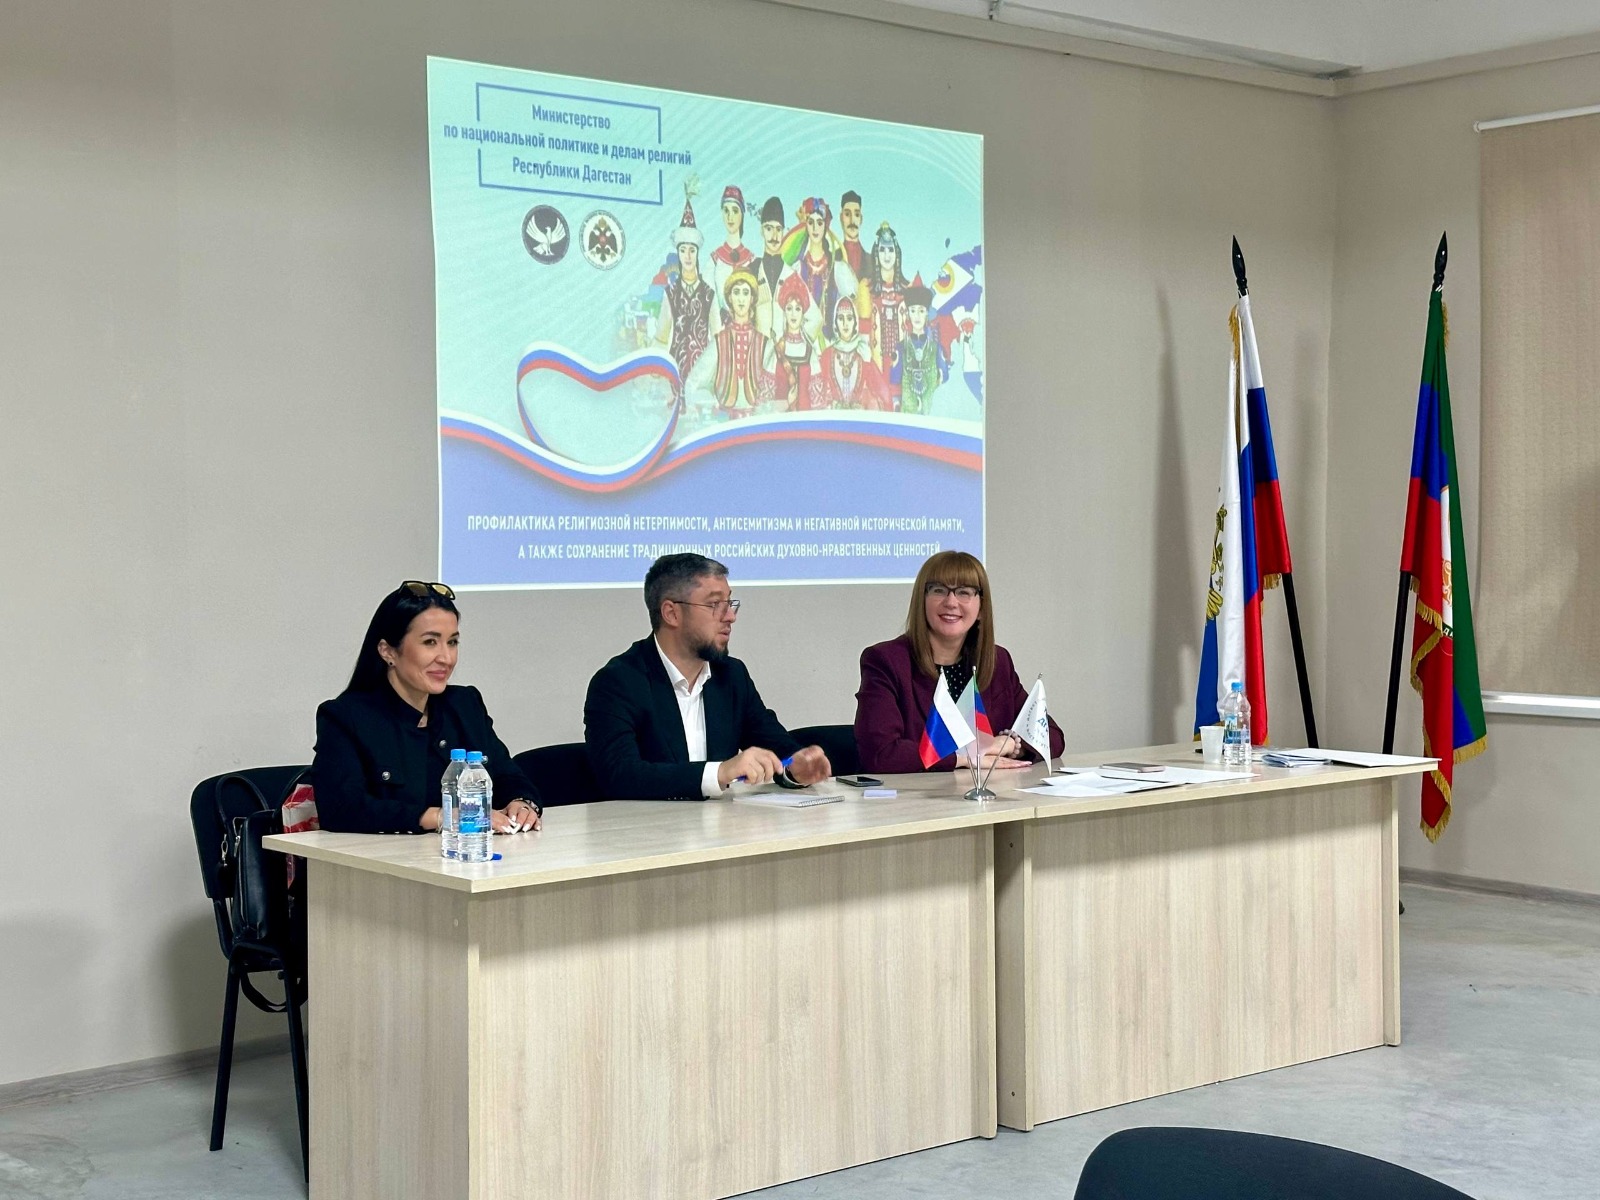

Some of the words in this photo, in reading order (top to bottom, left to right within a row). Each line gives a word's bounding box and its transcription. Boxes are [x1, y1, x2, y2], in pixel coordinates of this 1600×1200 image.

[532, 104, 611, 129] Министерство
[443, 125, 458, 138] по
[461, 127, 545, 148] национальной
[548, 137, 599, 155] политике
[602, 144, 608, 156] и
[611, 145, 645, 160] делам
[648, 150, 692, 165] религий
[512, 157, 580, 179] Республики
[582, 165, 632, 185] Дагестан
[468, 515, 555, 530] ПРОФИЛАКТИКА
[558, 514, 630, 530] РЕЛИГИОЗНОЙ
[633, 516, 711, 532] НЕТЕРПИМОСТИ,
[714, 516, 794, 531] АНТИСЕМИТИЗМА
[796, 517, 802, 530] И
[804, 515, 860, 530] НЕГАТИВНОЙ
[862, 516, 926, 531] ИСТОРИЧЕСКОЙ
[929, 517, 965, 533] ПАМЯТИ,
[518, 545, 526, 558] А
[528, 544, 564, 558] ТАКЖЕ
[566, 544, 629, 558] СОХРАНЕНИЕ
[714, 542, 775, 558] РОССИЙСКИХ
[777, 543, 892, 559] ДУХОВНО-НРАВСТВЕННЫХ
[894, 541, 940, 558] ЦЕННОСТЕЙ
